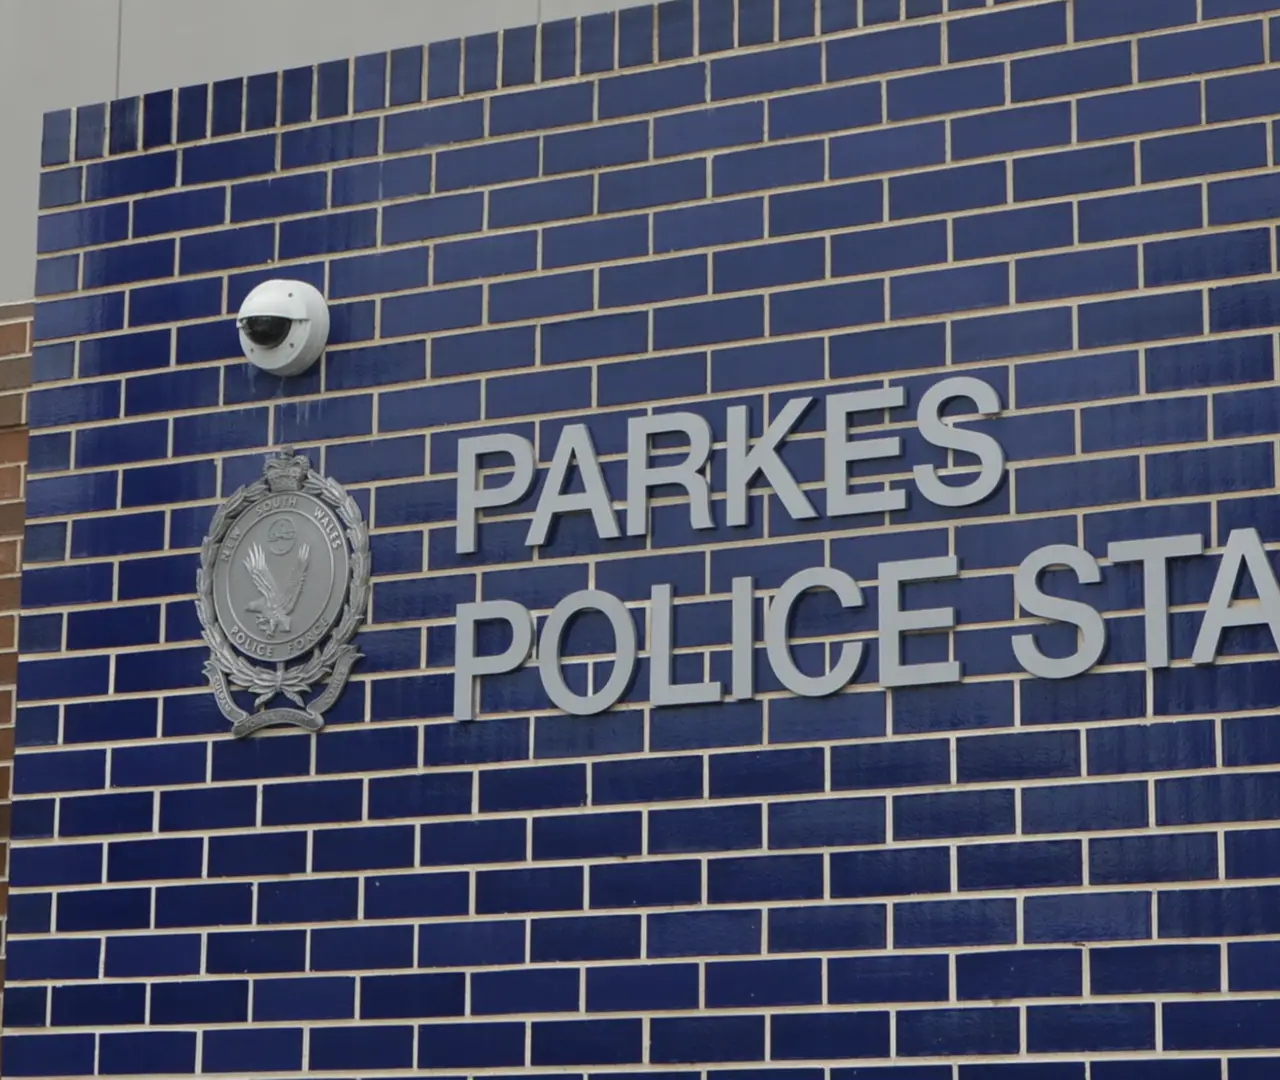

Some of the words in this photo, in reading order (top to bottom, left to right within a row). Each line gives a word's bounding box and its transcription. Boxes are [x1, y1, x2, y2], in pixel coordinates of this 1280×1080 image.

[455, 376, 1007, 554] PARKES
[221, 524, 240, 562] NEW
[255, 496, 297, 517] SOUTH
[314, 506, 342, 551] WALES
[230, 624, 274, 657] POLICE
[287, 617, 329, 654] FORCE
[453, 555, 962, 721] POLICE
